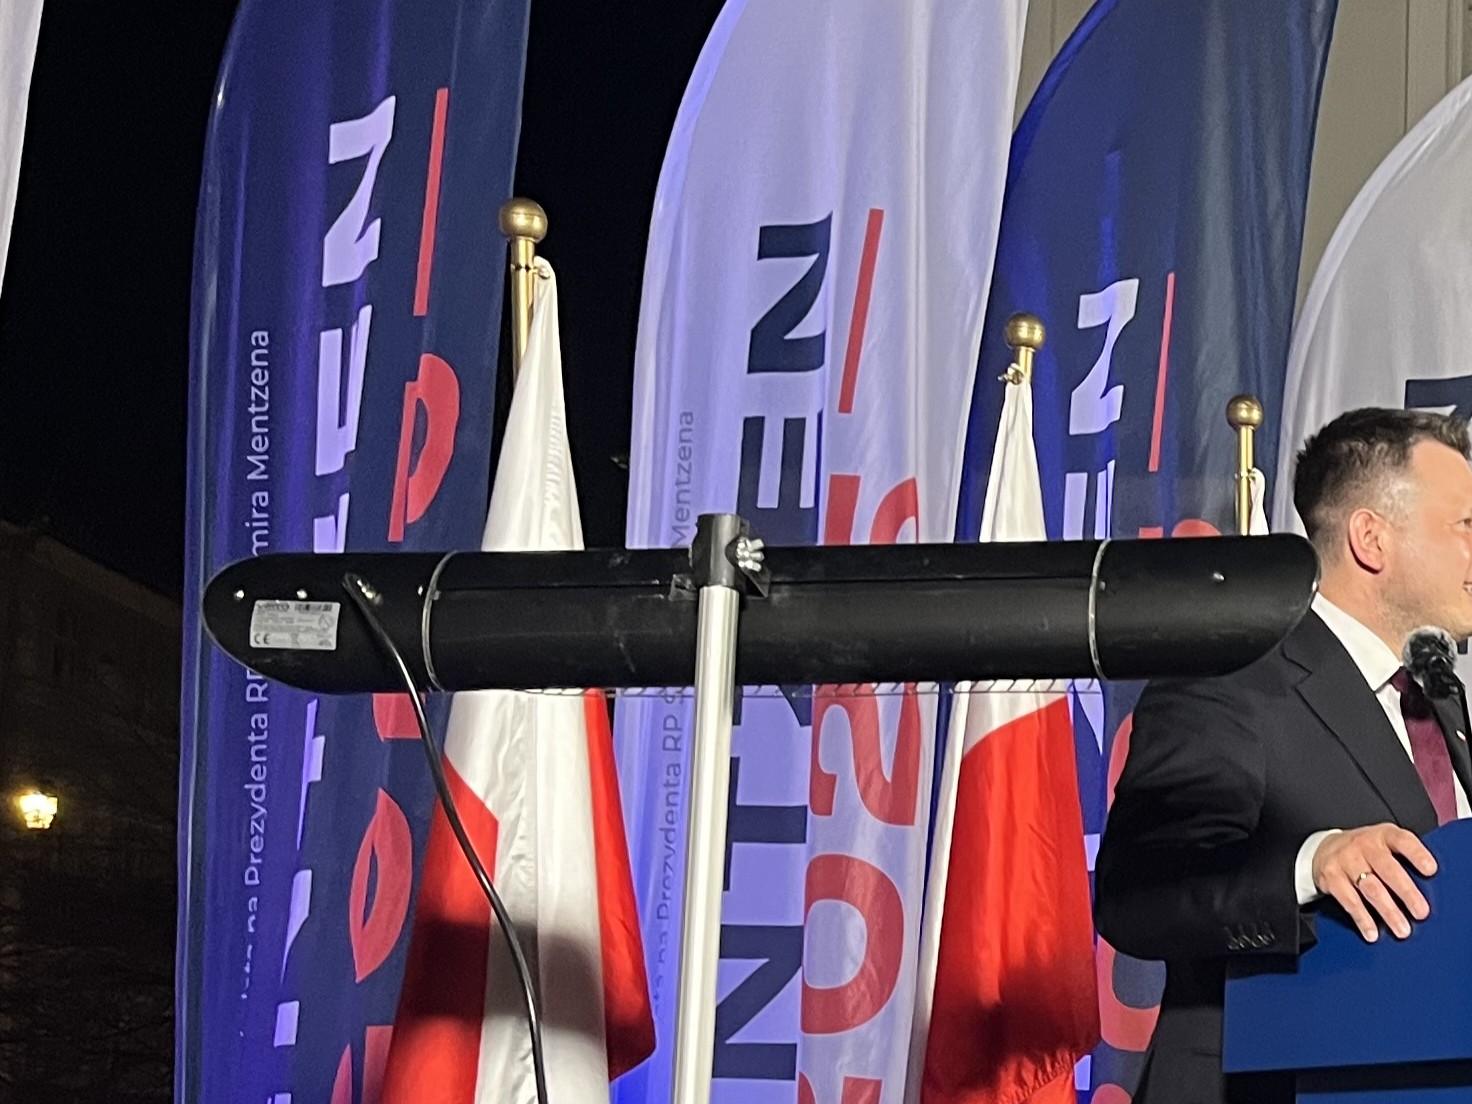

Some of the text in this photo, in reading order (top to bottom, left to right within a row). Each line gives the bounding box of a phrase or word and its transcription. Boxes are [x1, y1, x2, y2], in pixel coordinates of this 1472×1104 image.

[246, 329, 270, 482] Mentzena
[670, 410, 694, 547] Mentzena
[244, 715, 268, 886] Prezydenta
[662, 714, 683, 757] RP
